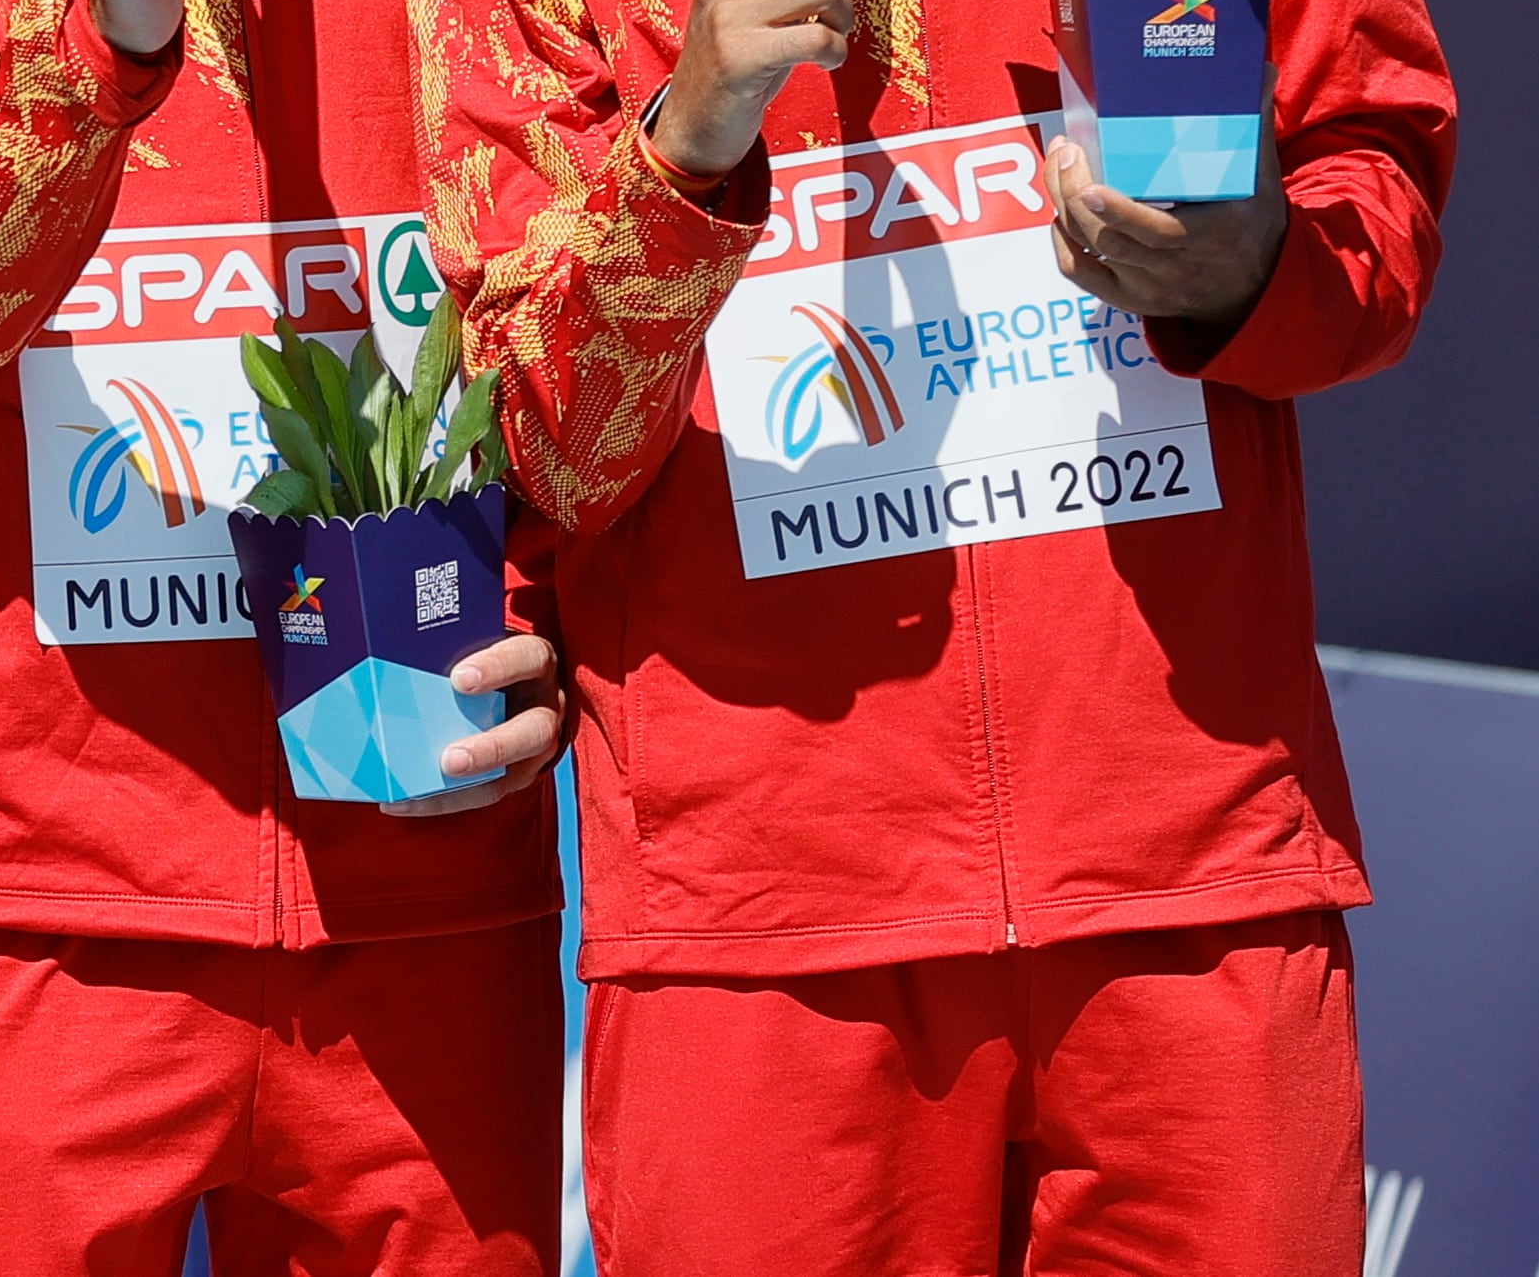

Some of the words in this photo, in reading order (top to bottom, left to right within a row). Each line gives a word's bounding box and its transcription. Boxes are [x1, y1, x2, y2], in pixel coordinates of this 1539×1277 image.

[1143, 24, 1216, 38] EUROPEAN
[1143, 37, 1215, 47] CHAMPIONSHIPS
[1143, 46, 1186, 57] MUNICH
[1188, 46, 1215, 57] 2022
[43, 243, 363, 332] SPAR
[916, 294, 1144, 359] EUROPEA
[925, 331, 1160, 401] ATHLETIC
[771, 469, 1025, 562] MUNICH
[1049, 444, 1190, 514] 2022
[278, 611, 324, 626] EUROPEAN
[283, 633, 310, 644] MUNICH
[311, 635, 329, 646] 2022
